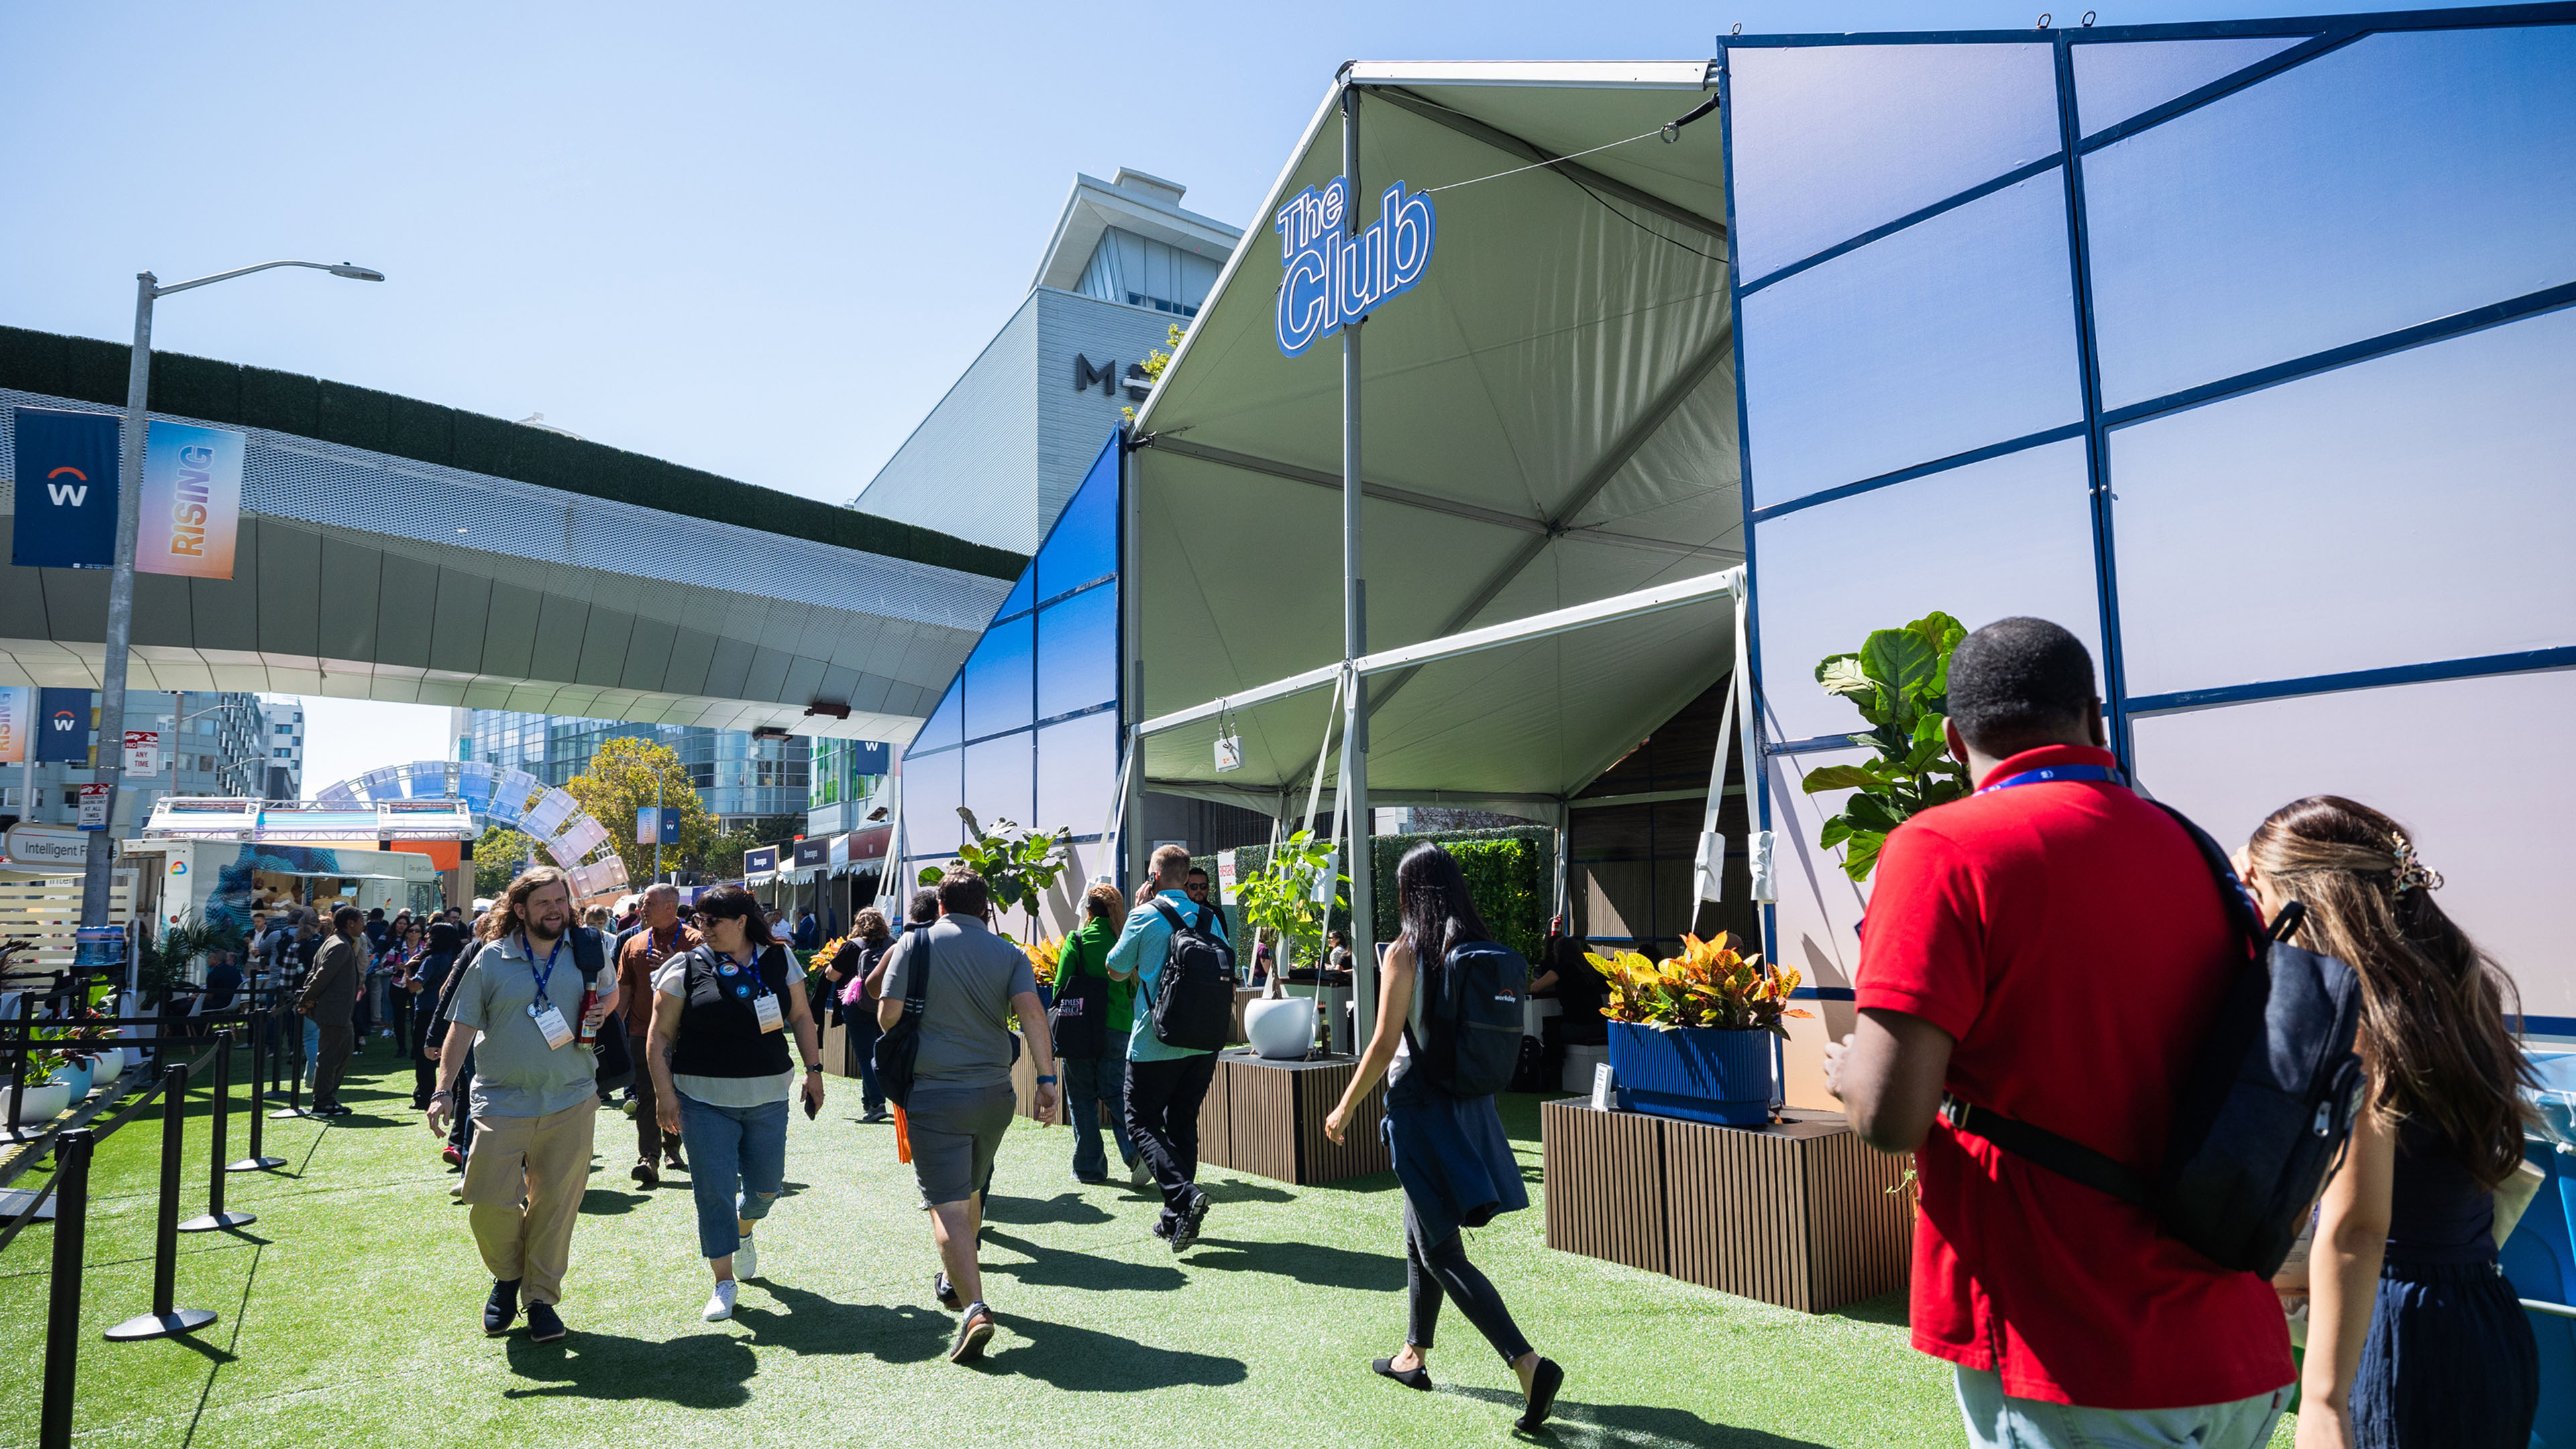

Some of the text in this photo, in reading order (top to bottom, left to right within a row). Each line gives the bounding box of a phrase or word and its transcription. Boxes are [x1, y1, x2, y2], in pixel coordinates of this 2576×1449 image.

[1277, 182, 1346, 259] The
[1277, 189, 1432, 351] Club
[170, 445, 215, 558] RISING
[25, 842, 77, 858] Intelligent
[1495, 995, 1517, 1004] workday
